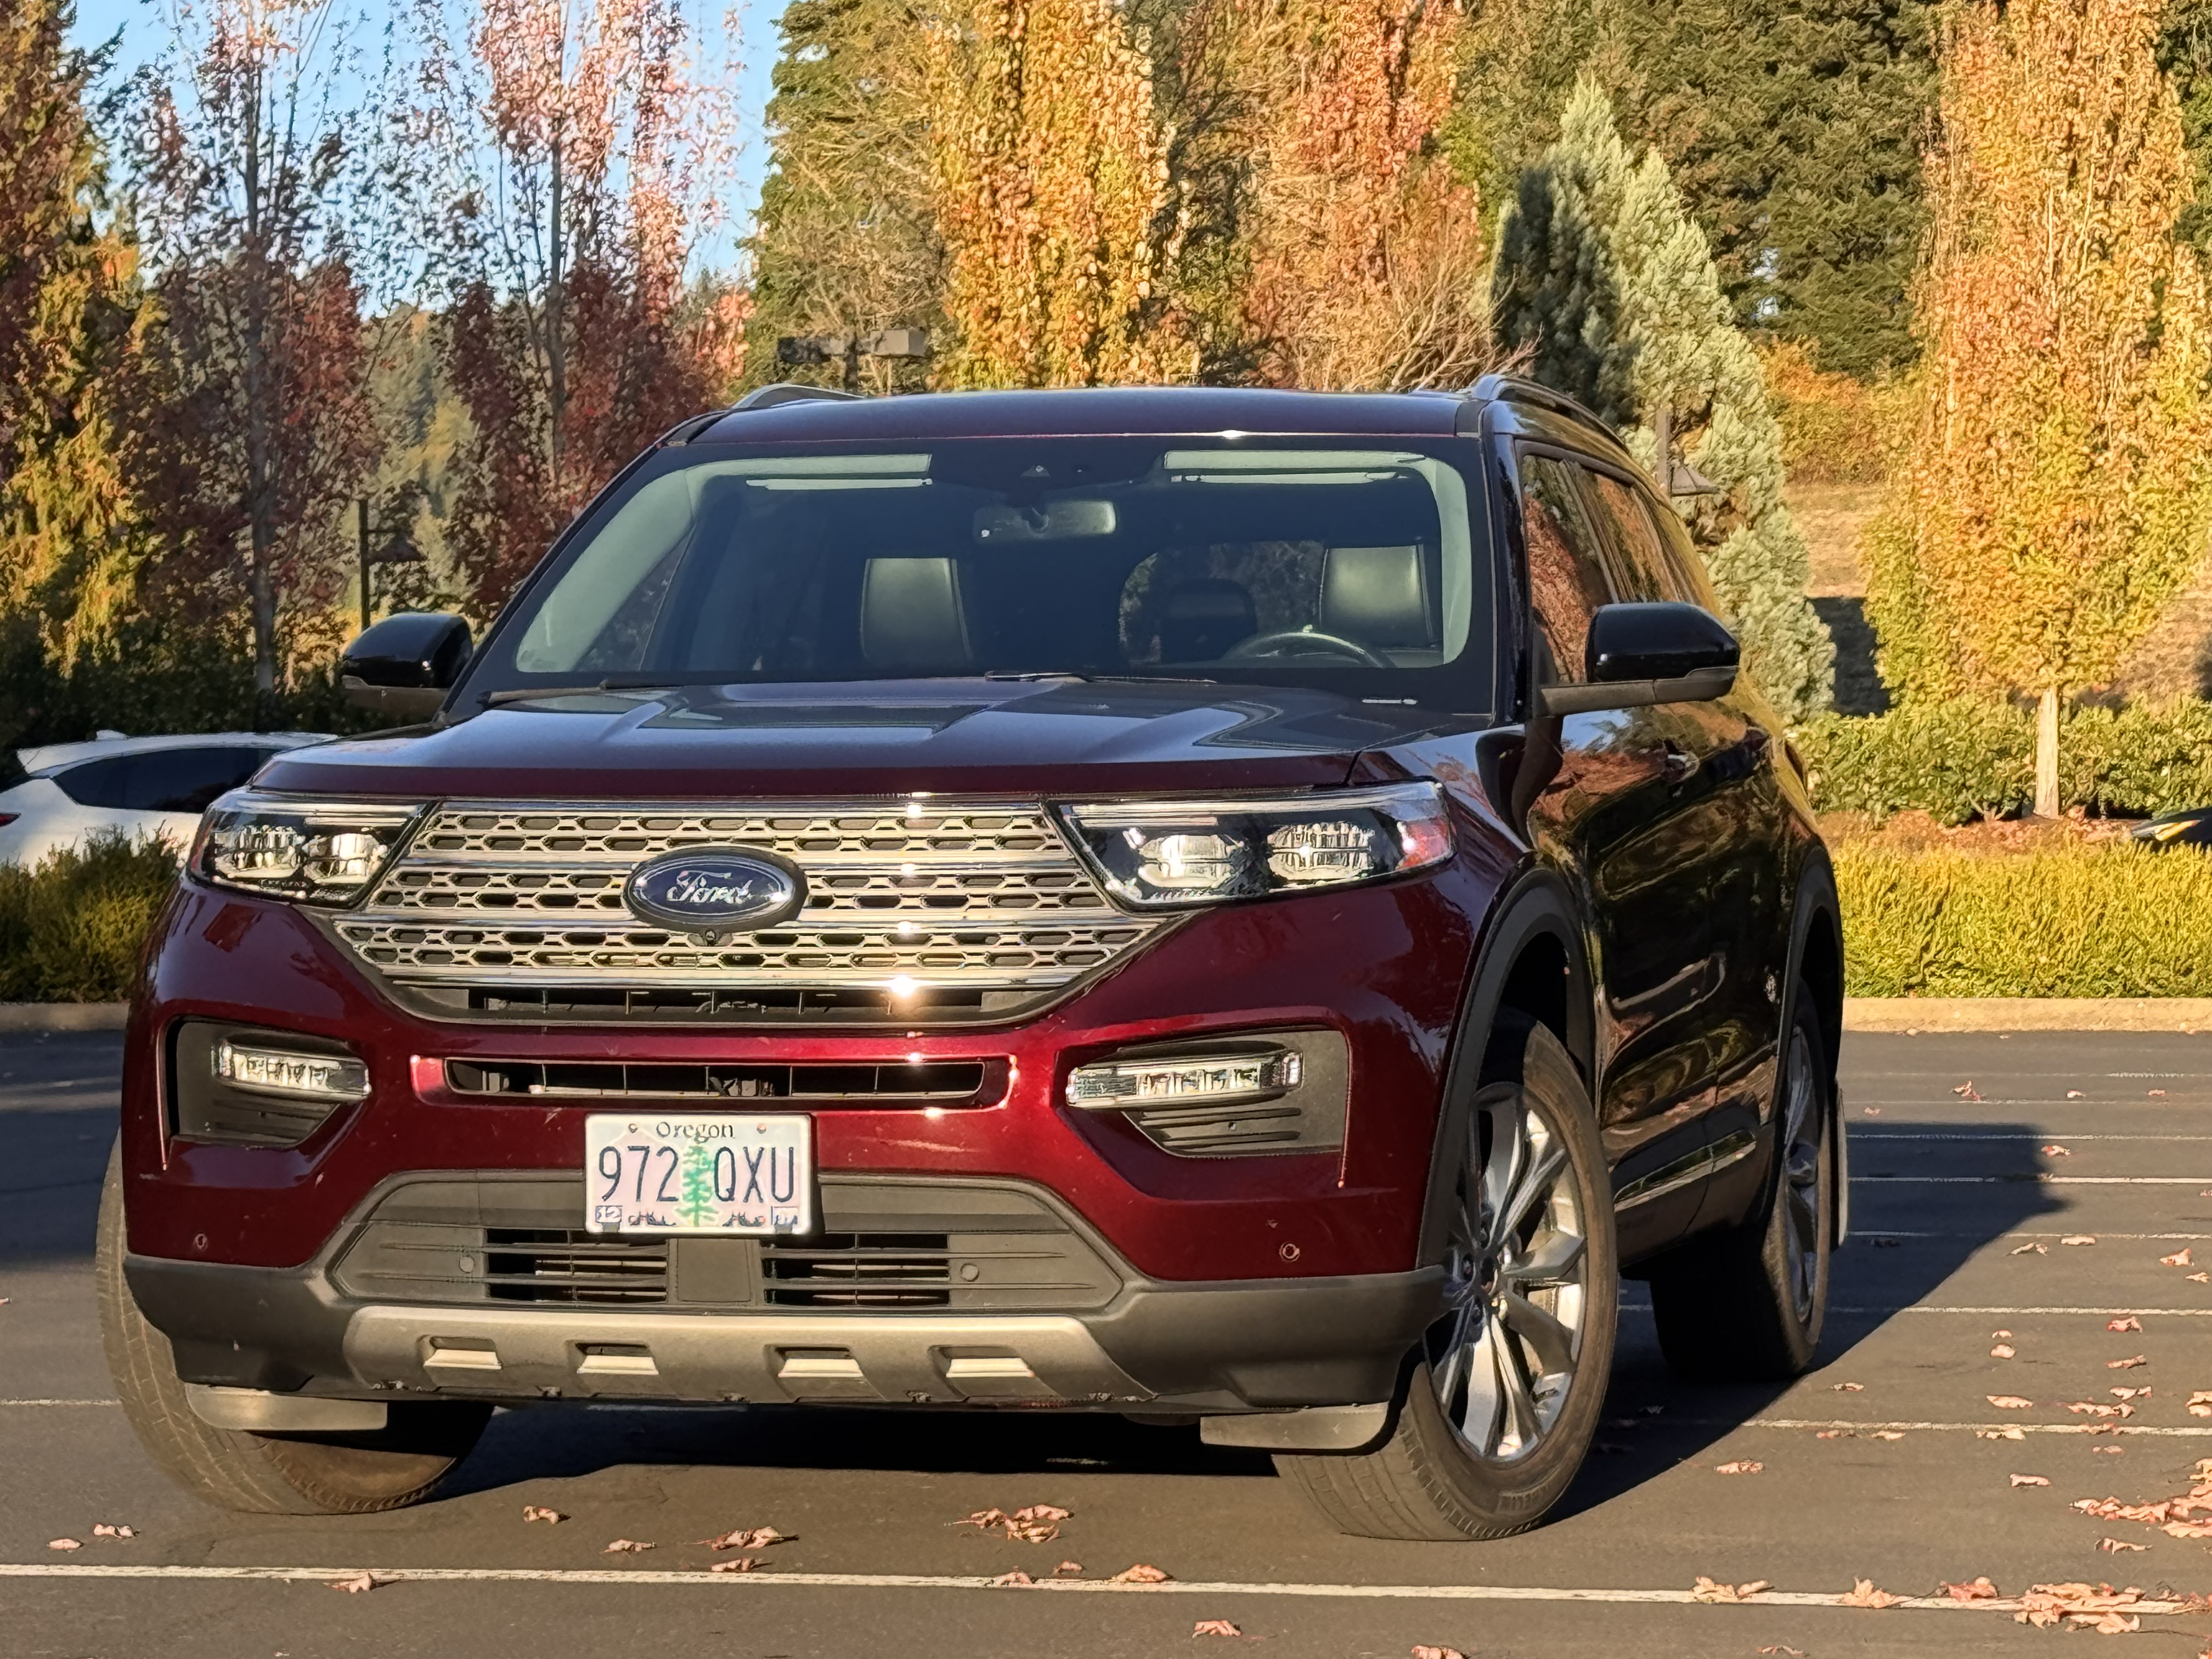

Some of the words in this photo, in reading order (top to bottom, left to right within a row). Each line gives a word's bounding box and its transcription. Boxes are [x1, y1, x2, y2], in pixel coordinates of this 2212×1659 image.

[667, 870, 754, 904] Ford
[656, 1121, 734, 1143] Oregon
[599, 1146, 679, 1203] 972
[714, 1147, 794, 1203] QXU
